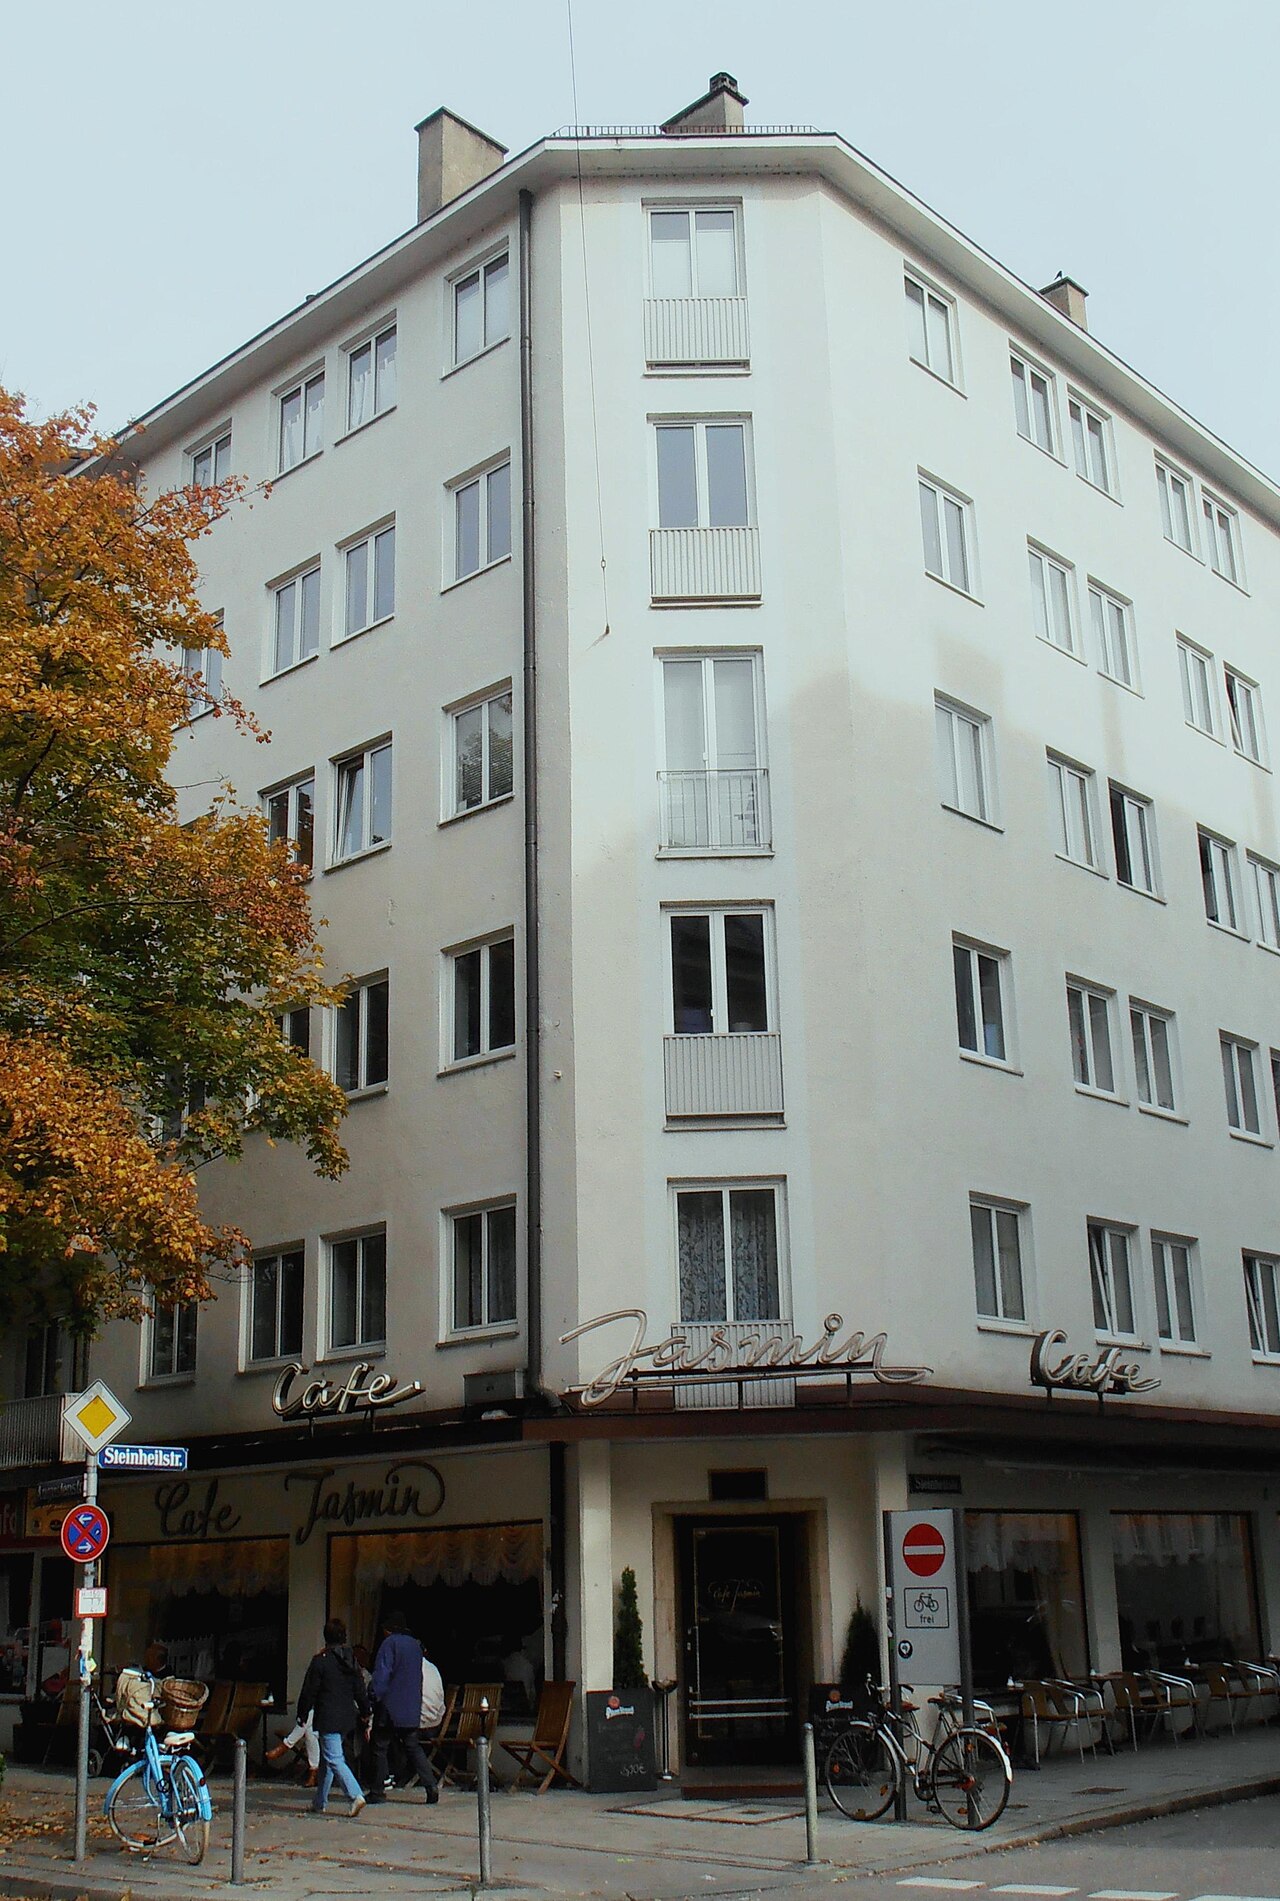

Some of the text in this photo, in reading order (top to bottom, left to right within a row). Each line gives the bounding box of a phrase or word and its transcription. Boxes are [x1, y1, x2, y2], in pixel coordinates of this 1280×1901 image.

[559, 1309, 934, 1406] Jasmin
[1030, 1328, 1161, 1395] Cafe
[272, 1361, 426, 1417] Cafe
[104, 1447, 183, 1466] Steinheilstr.
[155, 1461, 446, 1545] Cafe Jasmin
[919, 1614, 935, 1623] frei
